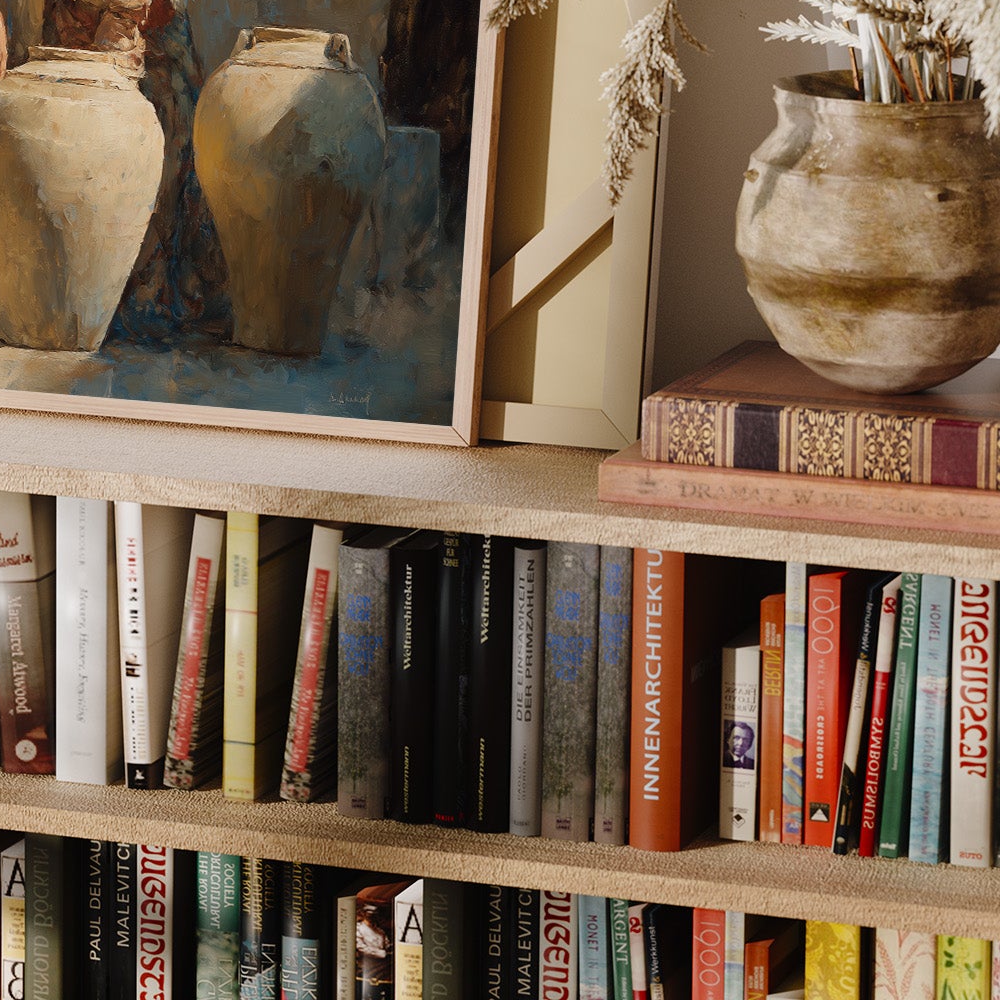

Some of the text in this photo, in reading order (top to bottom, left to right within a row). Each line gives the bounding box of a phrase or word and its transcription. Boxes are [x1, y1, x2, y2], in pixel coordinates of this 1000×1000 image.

[6, 595, 32, 714] Margaret Atwood
[403, 564, 413, 671] Weltarchitektur
[516, 573, 526, 687] EINSAMKEIT
[524, 559, 535, 723] DER PRIMZAHLEN
[643, 548, 663, 801] INNENARCHITEKTU
[89, 840, 101, 961] PAUL DELVAU
[518, 888, 532, 996] MALEVITC
[587, 914, 599, 952] MONET
[648, 926, 659, 975] Werkkunst
[695, 921, 721, 987] 1900
